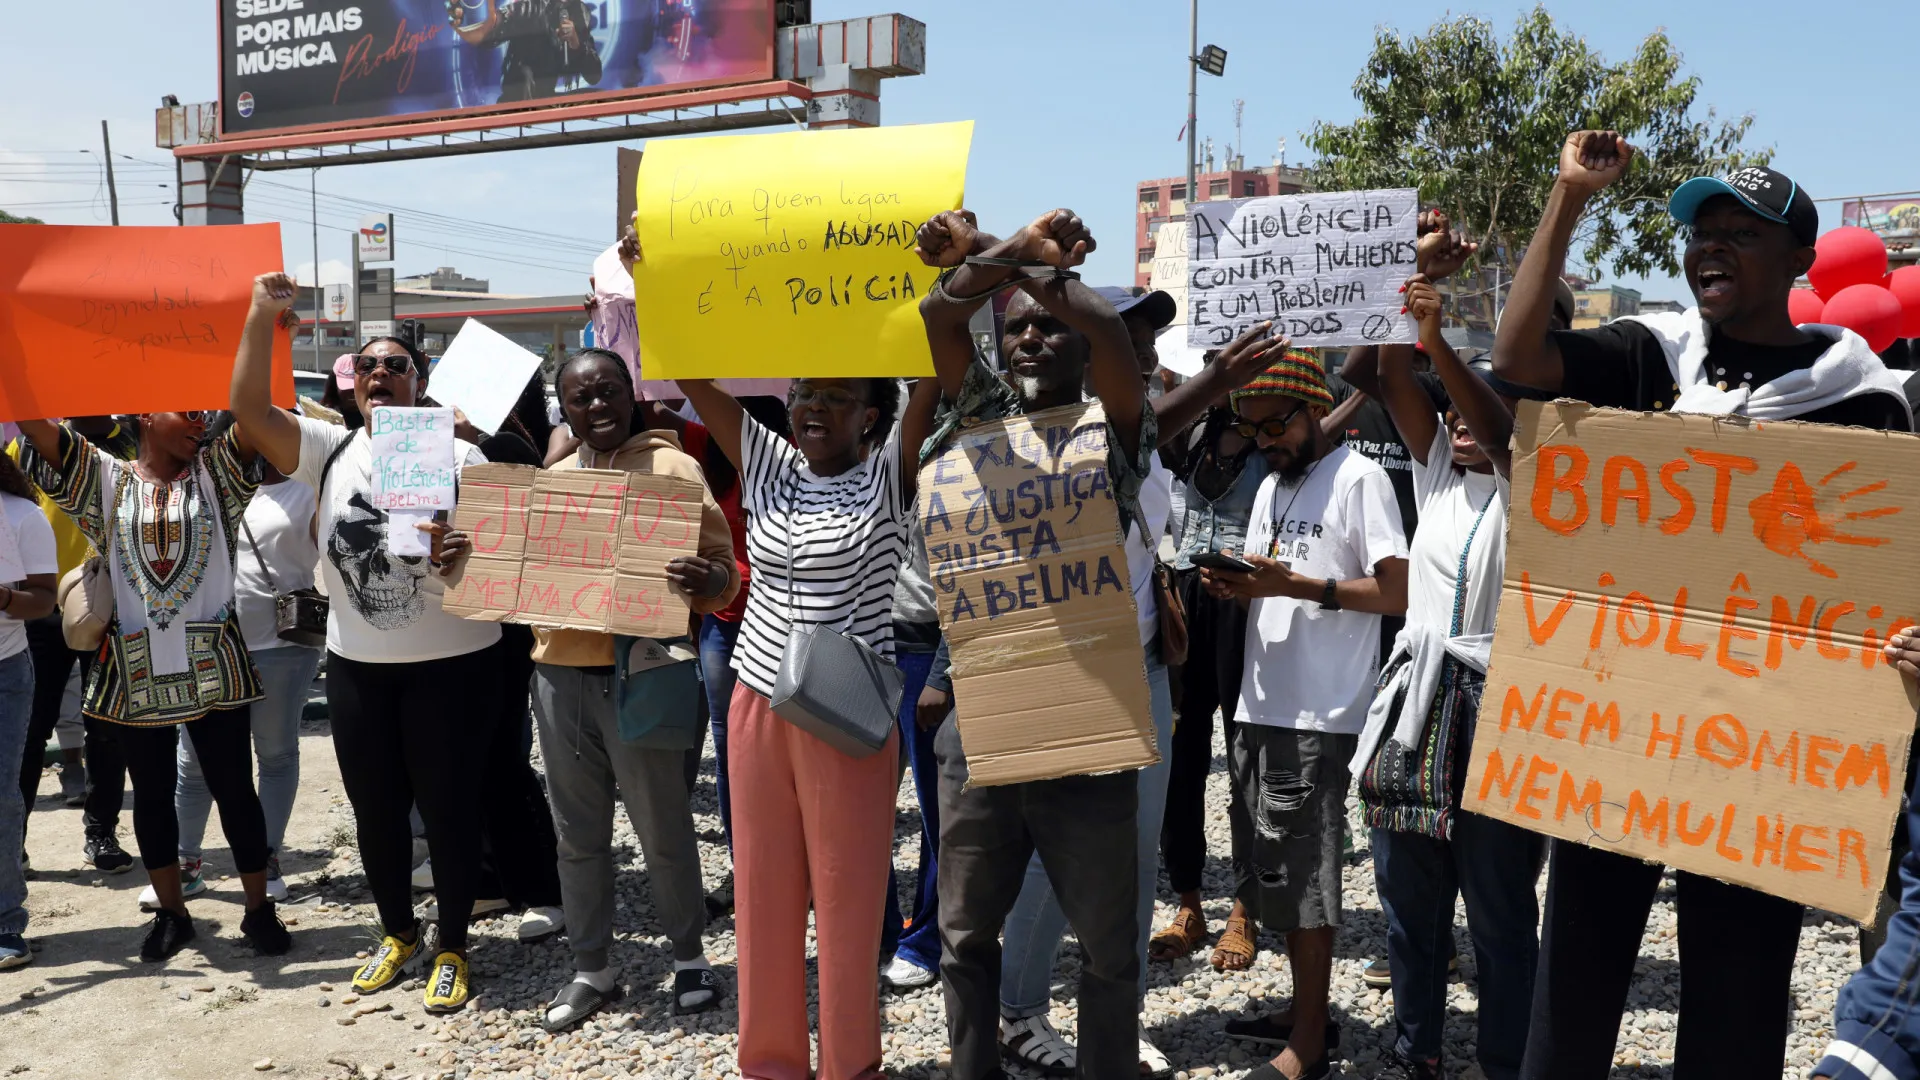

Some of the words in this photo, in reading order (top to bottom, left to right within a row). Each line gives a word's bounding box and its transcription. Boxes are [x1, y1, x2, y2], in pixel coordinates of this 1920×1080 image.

[236, 18, 290, 47] POR
[294, 7, 363, 38] MAIS
[236, 41, 338, 76] MÚSICA
[670, 166, 734, 240] Para
[840, 180, 901, 223] ligar
[1194, 213, 1218, 261] A
[720, 229, 807, 289] quando
[697, 280, 713, 314] É
[745, 285, 762, 306] A
[1219, 290, 1261, 318] UM
[373, 408, 439, 436] Basta
[395, 433, 420, 453] de
[1362, 440, 1381, 454] Paz,
[1383, 442, 1404, 457] Pão,
[1381, 456, 1412, 471] Liberd
[925, 491, 954, 537] A
[1531, 444, 1824, 543] BASTA
[467, 481, 691, 553] JUNTOS
[530, 536, 616, 570] PELA
[456, 575, 561, 616] MESMA
[571, 582, 665, 622] CAUSA
[952, 587, 979, 624] A
[982, 555, 1125, 621] BELMA
[1499, 682, 1620, 747] NEM
[1645, 713, 1891, 798] HOMEM
[1478, 747, 1602, 829] NEM
[1622, 789, 1871, 889] MULHER
[436, 964, 456, 996] DOLCE
